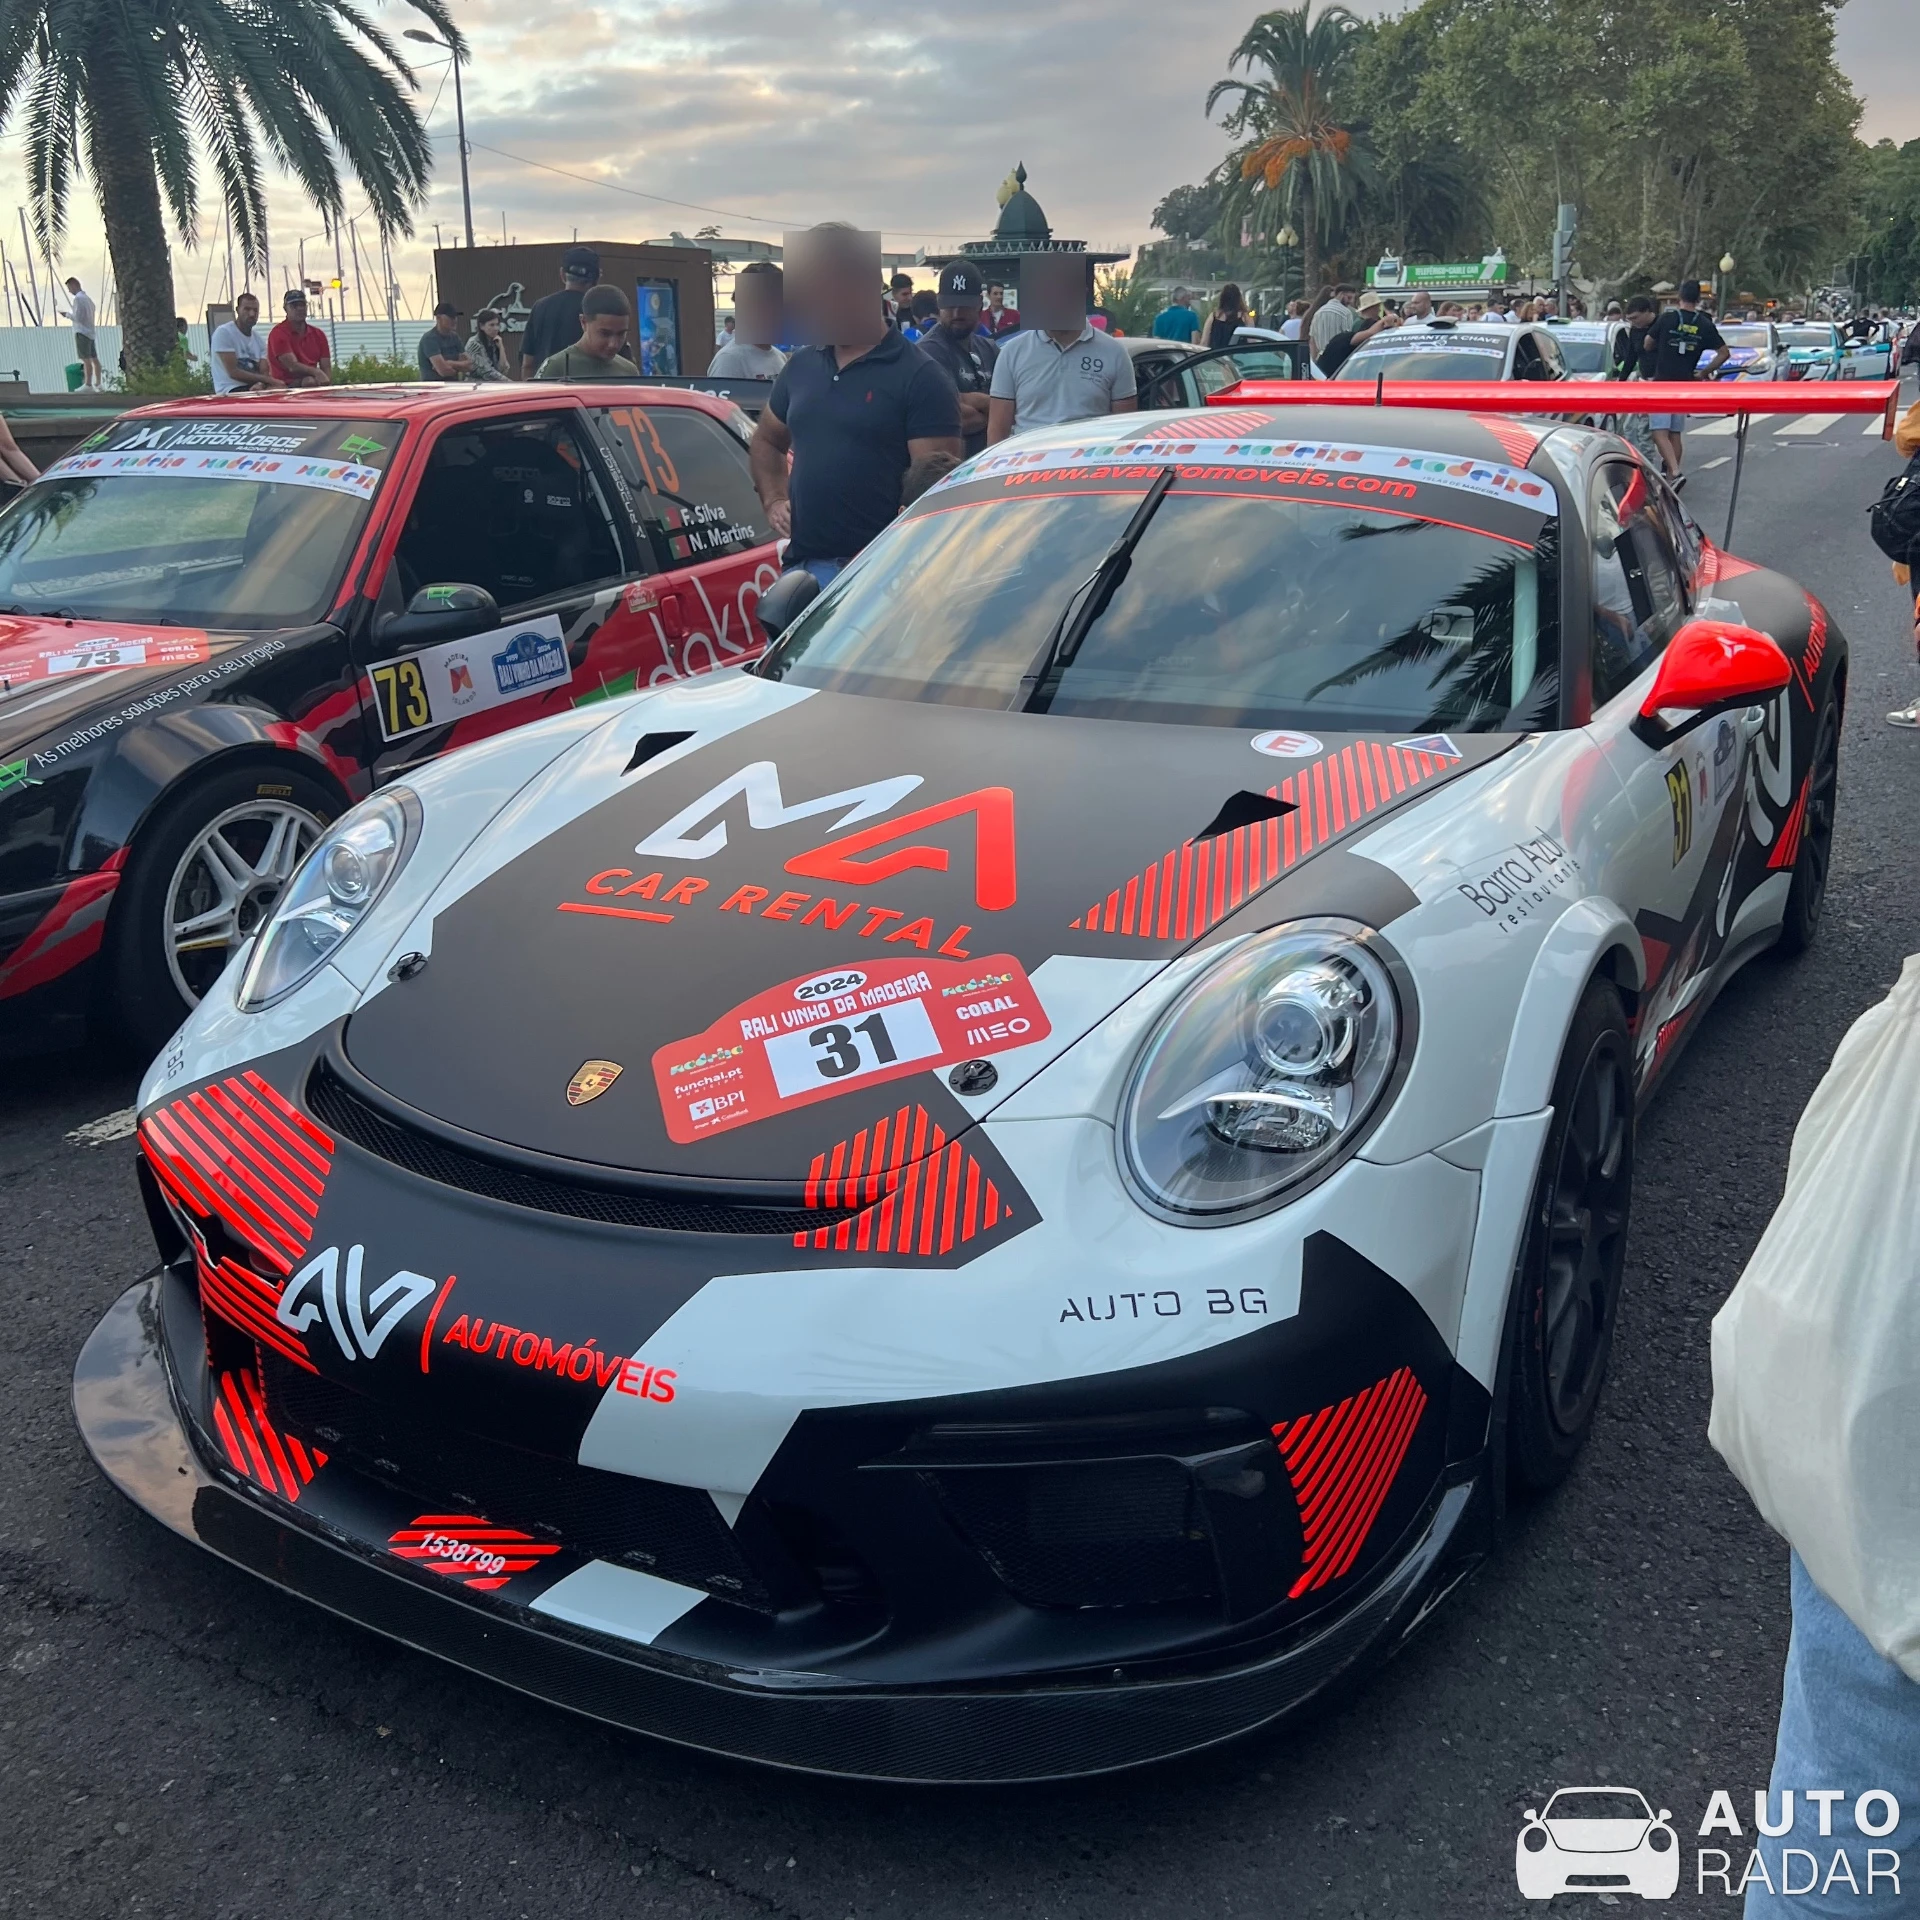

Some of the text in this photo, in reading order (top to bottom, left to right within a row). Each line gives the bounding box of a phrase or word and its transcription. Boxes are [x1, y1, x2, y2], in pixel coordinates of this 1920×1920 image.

[1461, 335, 1501, 346] CHAVE
[1081, 356, 1104, 373] 89
[175, 433, 307, 450] MOTORLOBOS
[187, 423, 269, 437] YELLOW
[610, 407, 680, 495] 73
[1002, 462, 1418, 499] www.avautomoveis.com
[680, 503, 727, 527] F. Silva
[688, 522, 755, 552] N. Martins
[111, 636, 154, 648] MADEIRA
[72, 650, 121, 669] 73
[443, 652, 469, 669] MADEIRA
[33, 638, 286, 768] As melhores soluções para o seu projeto
[373, 660, 429, 733] 73
[1456, 825, 1568, 917] Barra Azul
[1498, 859, 1581, 933] restaurante
[585, 868, 973, 960] CAR RENTAL
[797, 972, 864, 1000] 2024
[739, 1014, 780, 1041] RALI
[780, 1001, 831, 1028] VINHO
[833, 994, 858, 1014] DA
[859, 970, 933, 1007] MADEIRA
[955, 995, 1020, 1020] CORAL
[808, 1012, 898, 1078] 31
[966, 1017, 1031, 1045] MEO
[674, 1066, 743, 1095] funchal.pt
[713, 1089, 746, 1111] BPI
[1059, 1287, 1268, 1323] AUTO BG
[443, 1313, 679, 1404] AUTOMÓVEIS
[418, 1532, 507, 1575] 1538799
